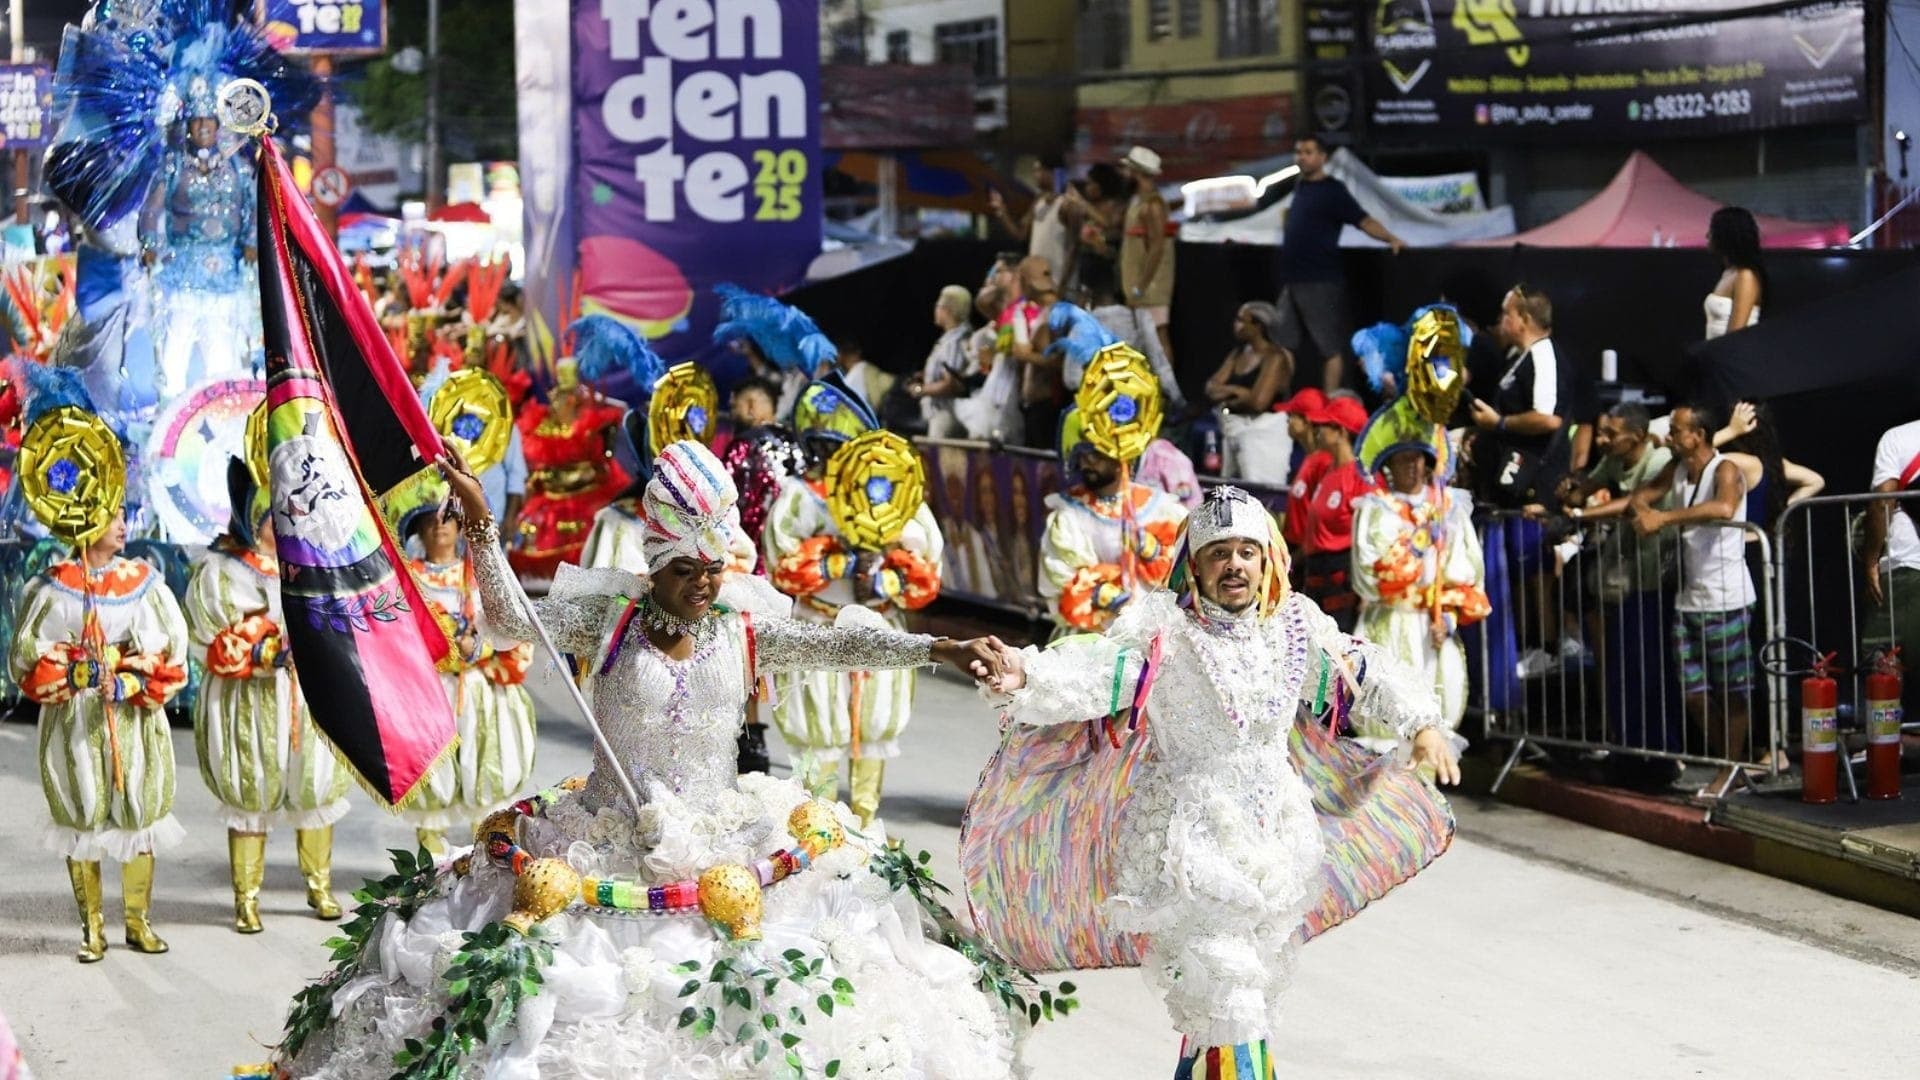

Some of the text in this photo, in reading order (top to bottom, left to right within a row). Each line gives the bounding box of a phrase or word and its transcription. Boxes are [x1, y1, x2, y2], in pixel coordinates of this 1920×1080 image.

[602, 56, 807, 142] den
[635, 139, 749, 223] te
[753, 149, 808, 185] 20
[753, 183, 802, 221] 25
